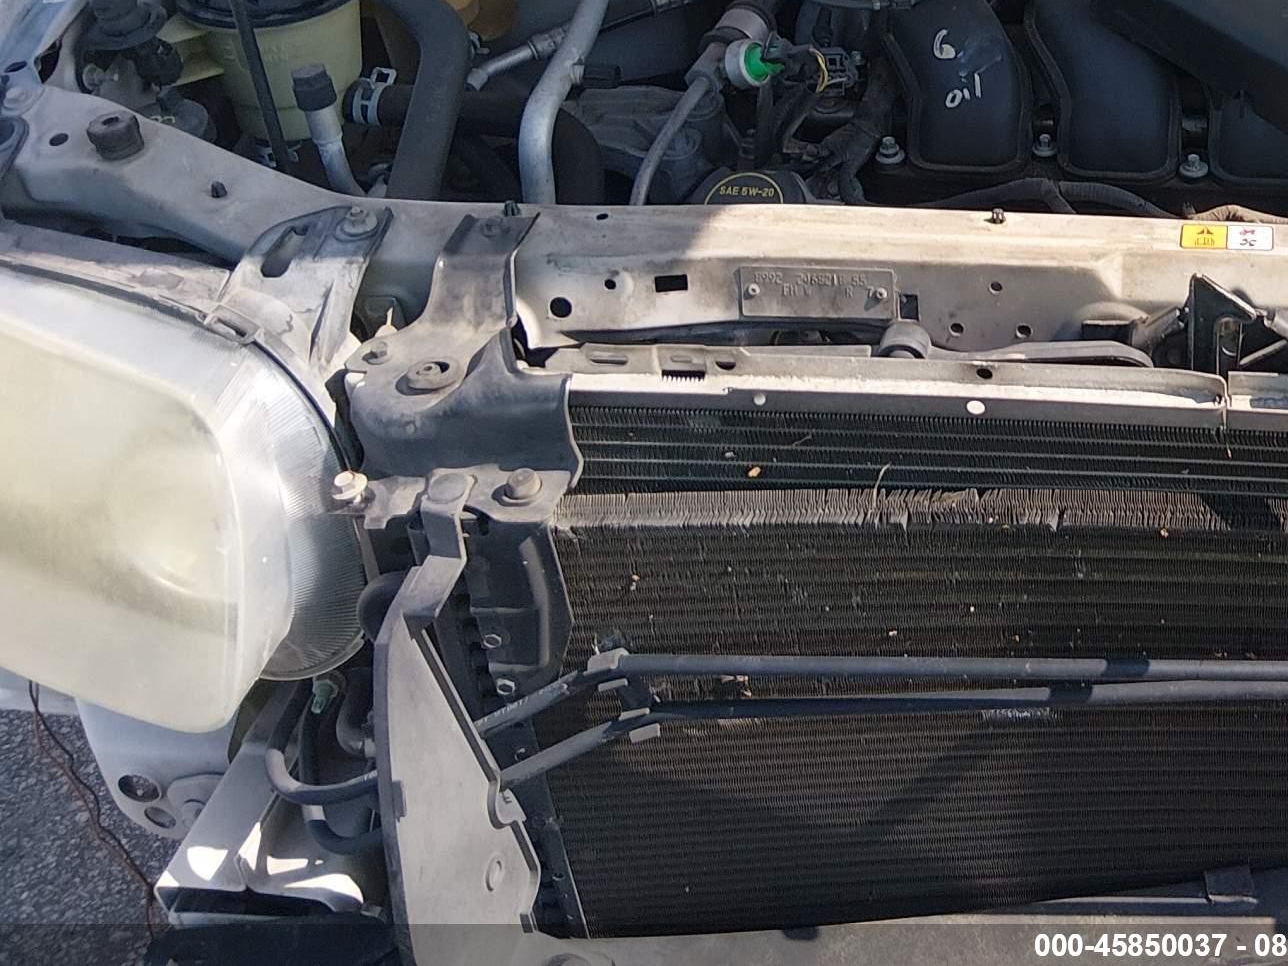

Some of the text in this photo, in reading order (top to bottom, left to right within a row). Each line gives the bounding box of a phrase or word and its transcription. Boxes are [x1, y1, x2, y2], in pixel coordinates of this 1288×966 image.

[933, 29, 956, 59] 6
[945, 72, 982, 108] oil
[720, 185, 775, 197] SAE 5W-20
